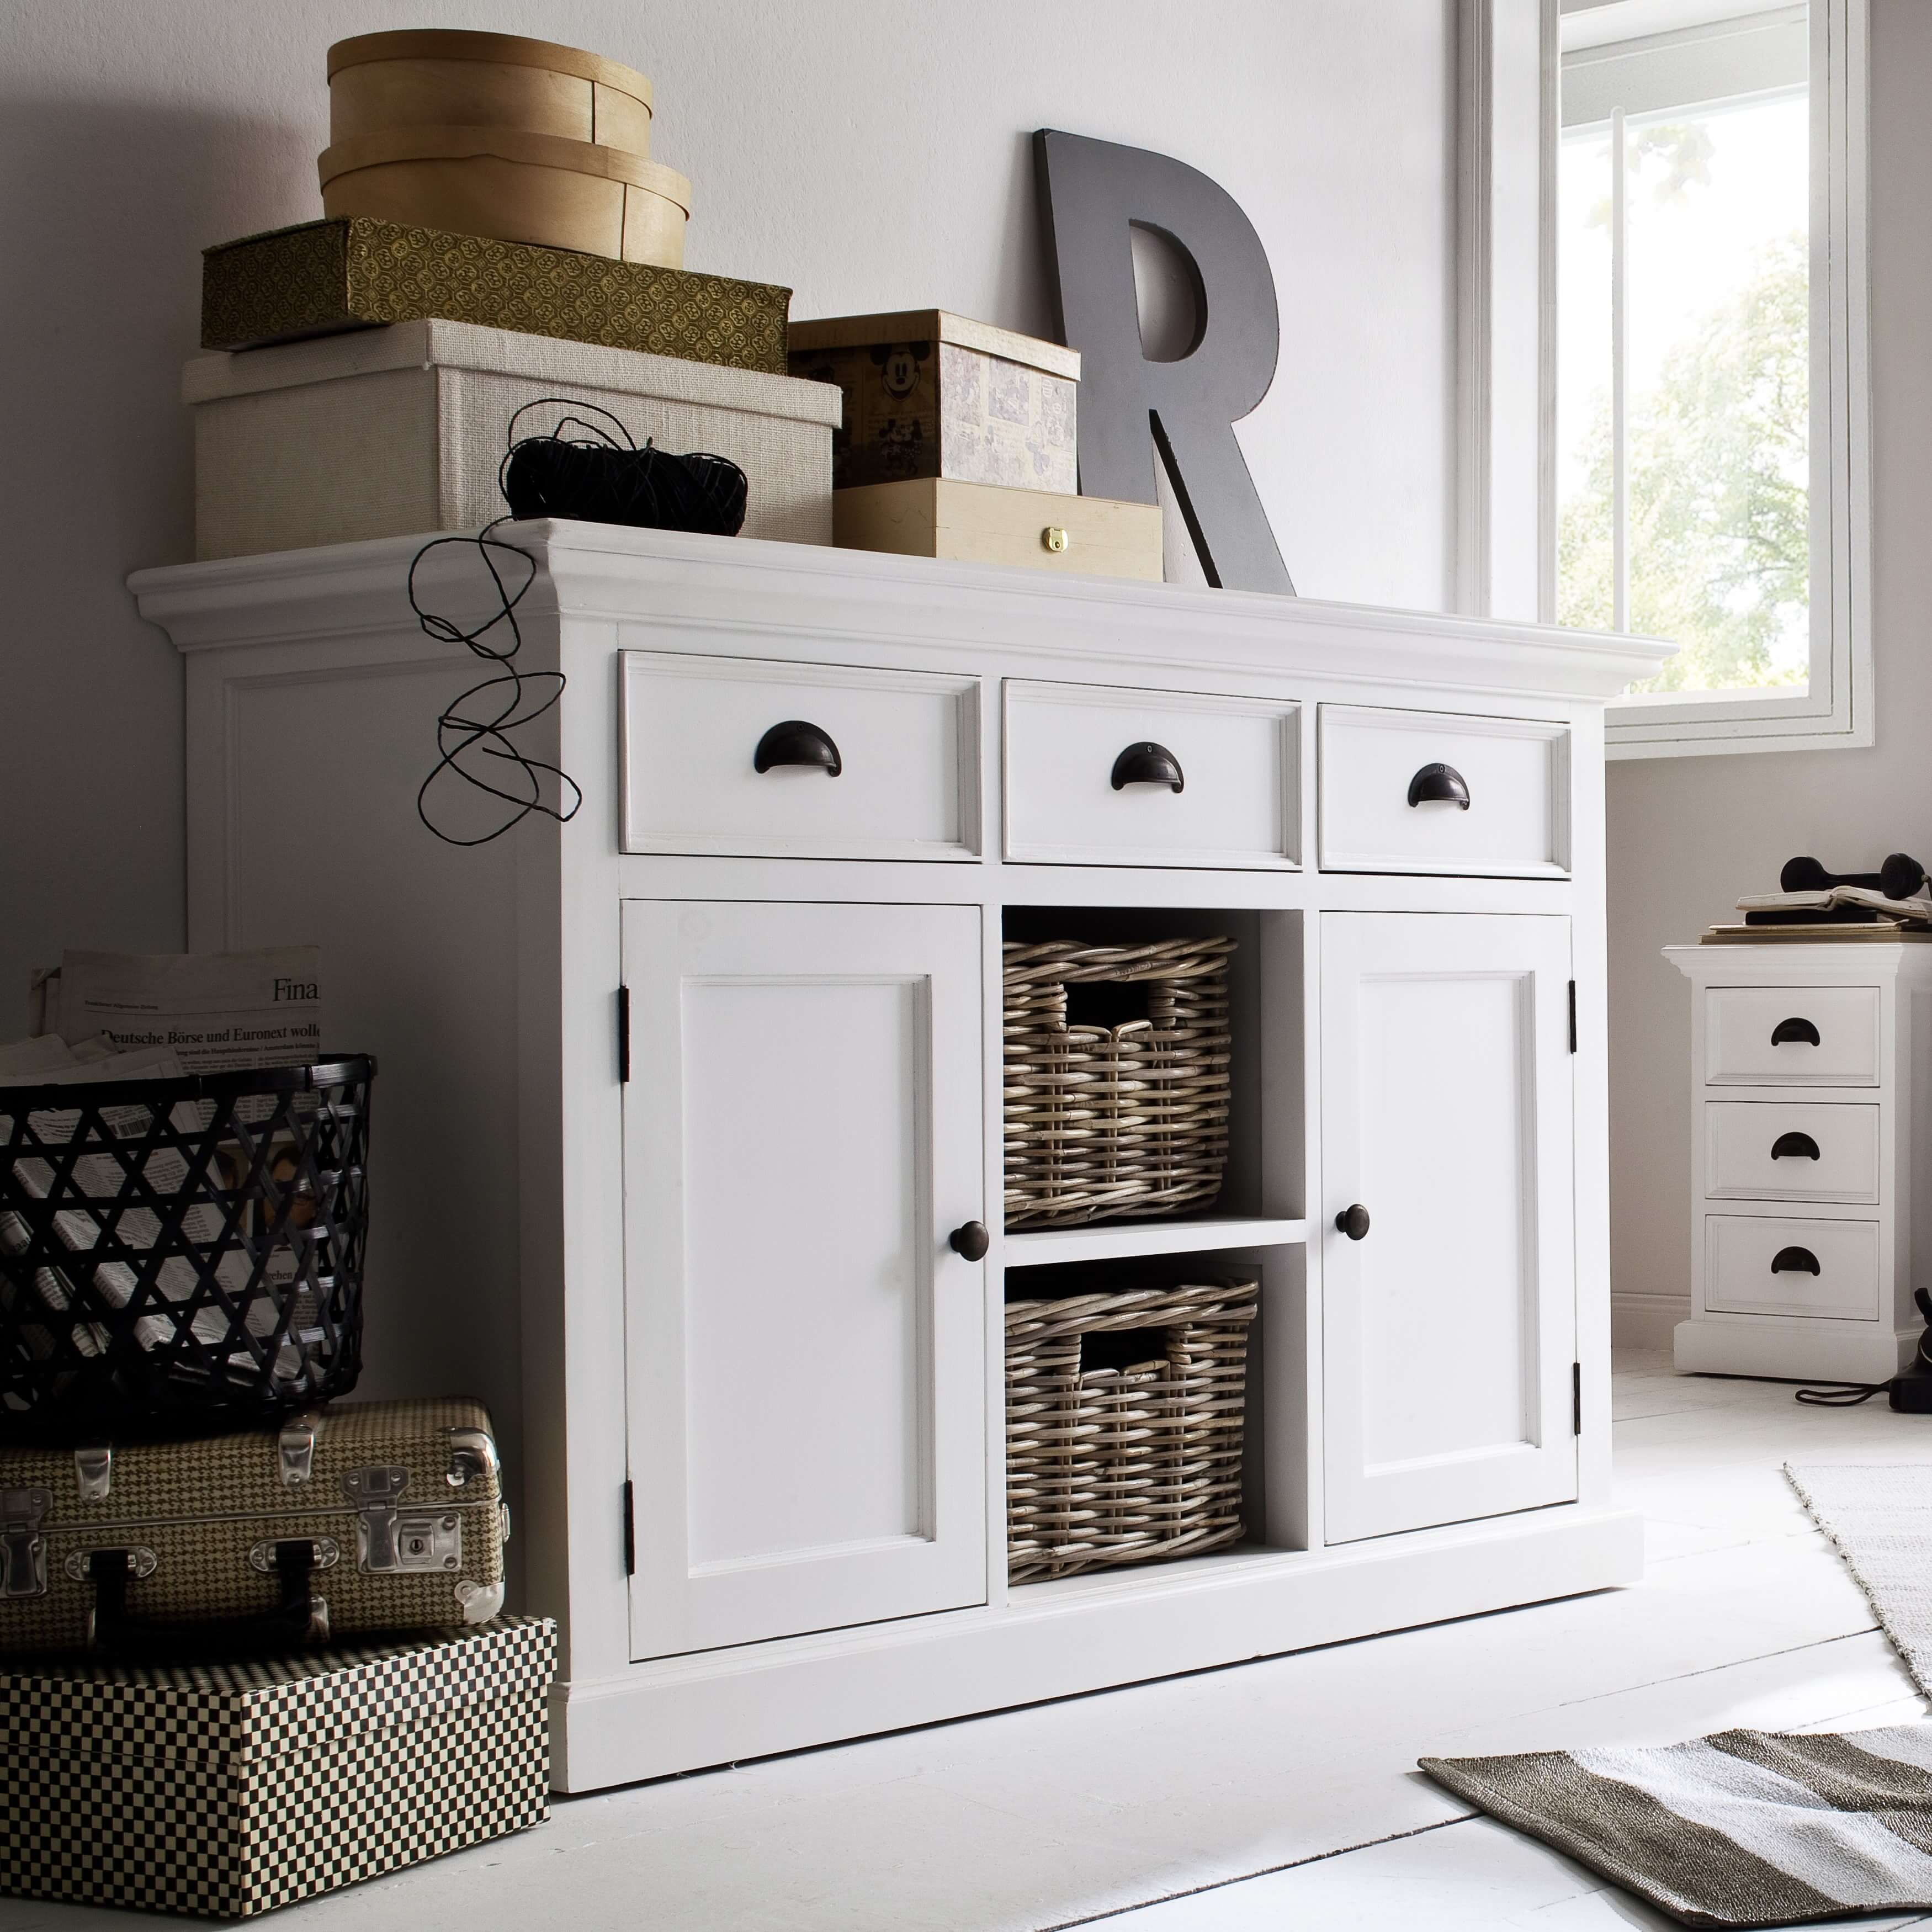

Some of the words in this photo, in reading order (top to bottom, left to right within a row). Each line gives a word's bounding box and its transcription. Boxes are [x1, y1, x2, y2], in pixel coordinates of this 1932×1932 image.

[273, 978, 319, 1002] Fina
[167, 1030, 204, 1044] Börse
[207, 1029, 230, 1043] und
[233, 1027, 287, 1042] Euronext
